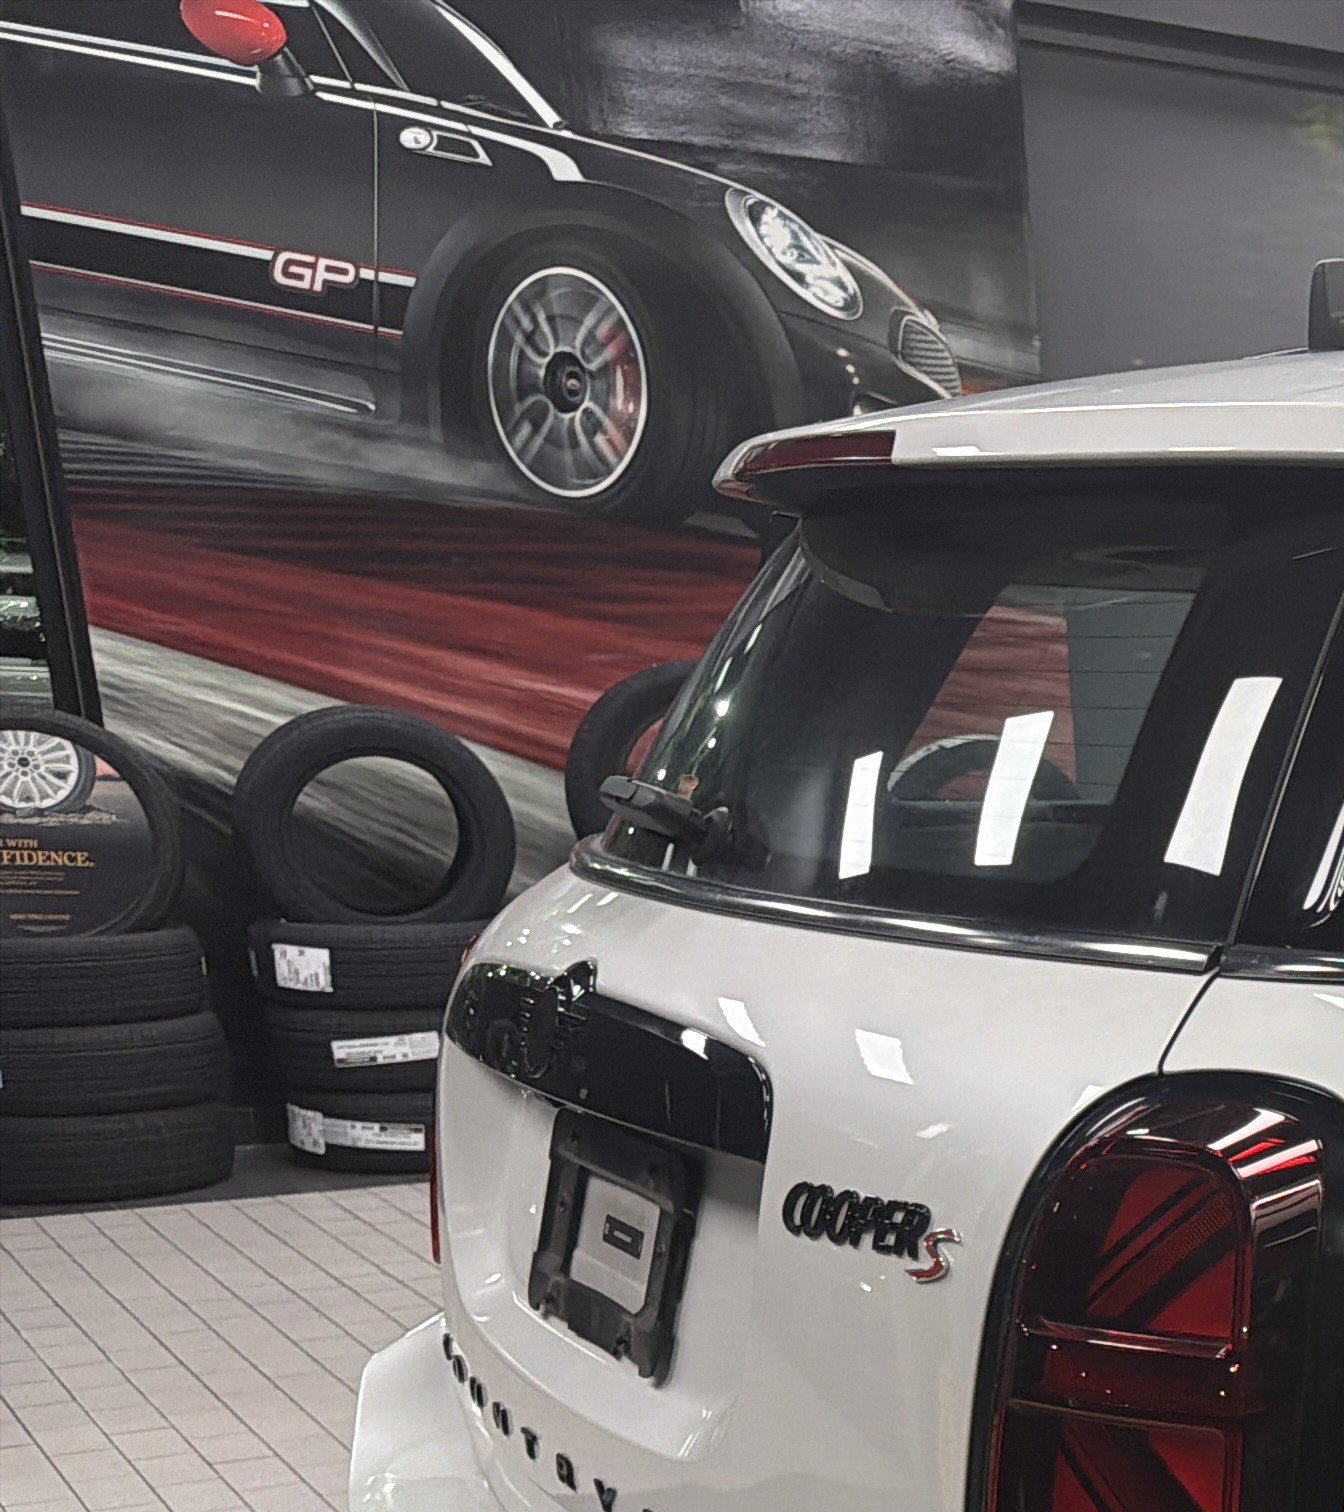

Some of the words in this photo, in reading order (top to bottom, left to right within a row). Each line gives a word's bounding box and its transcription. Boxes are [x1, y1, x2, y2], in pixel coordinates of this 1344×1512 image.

[272, 250, 357, 293] GP
[0, 850, 95, 867] FIDENCE.
[6, 838, 39, 849] WITH
[782, 1181, 932, 1261] COOPER
[904, 1227, 964, 1284] S
